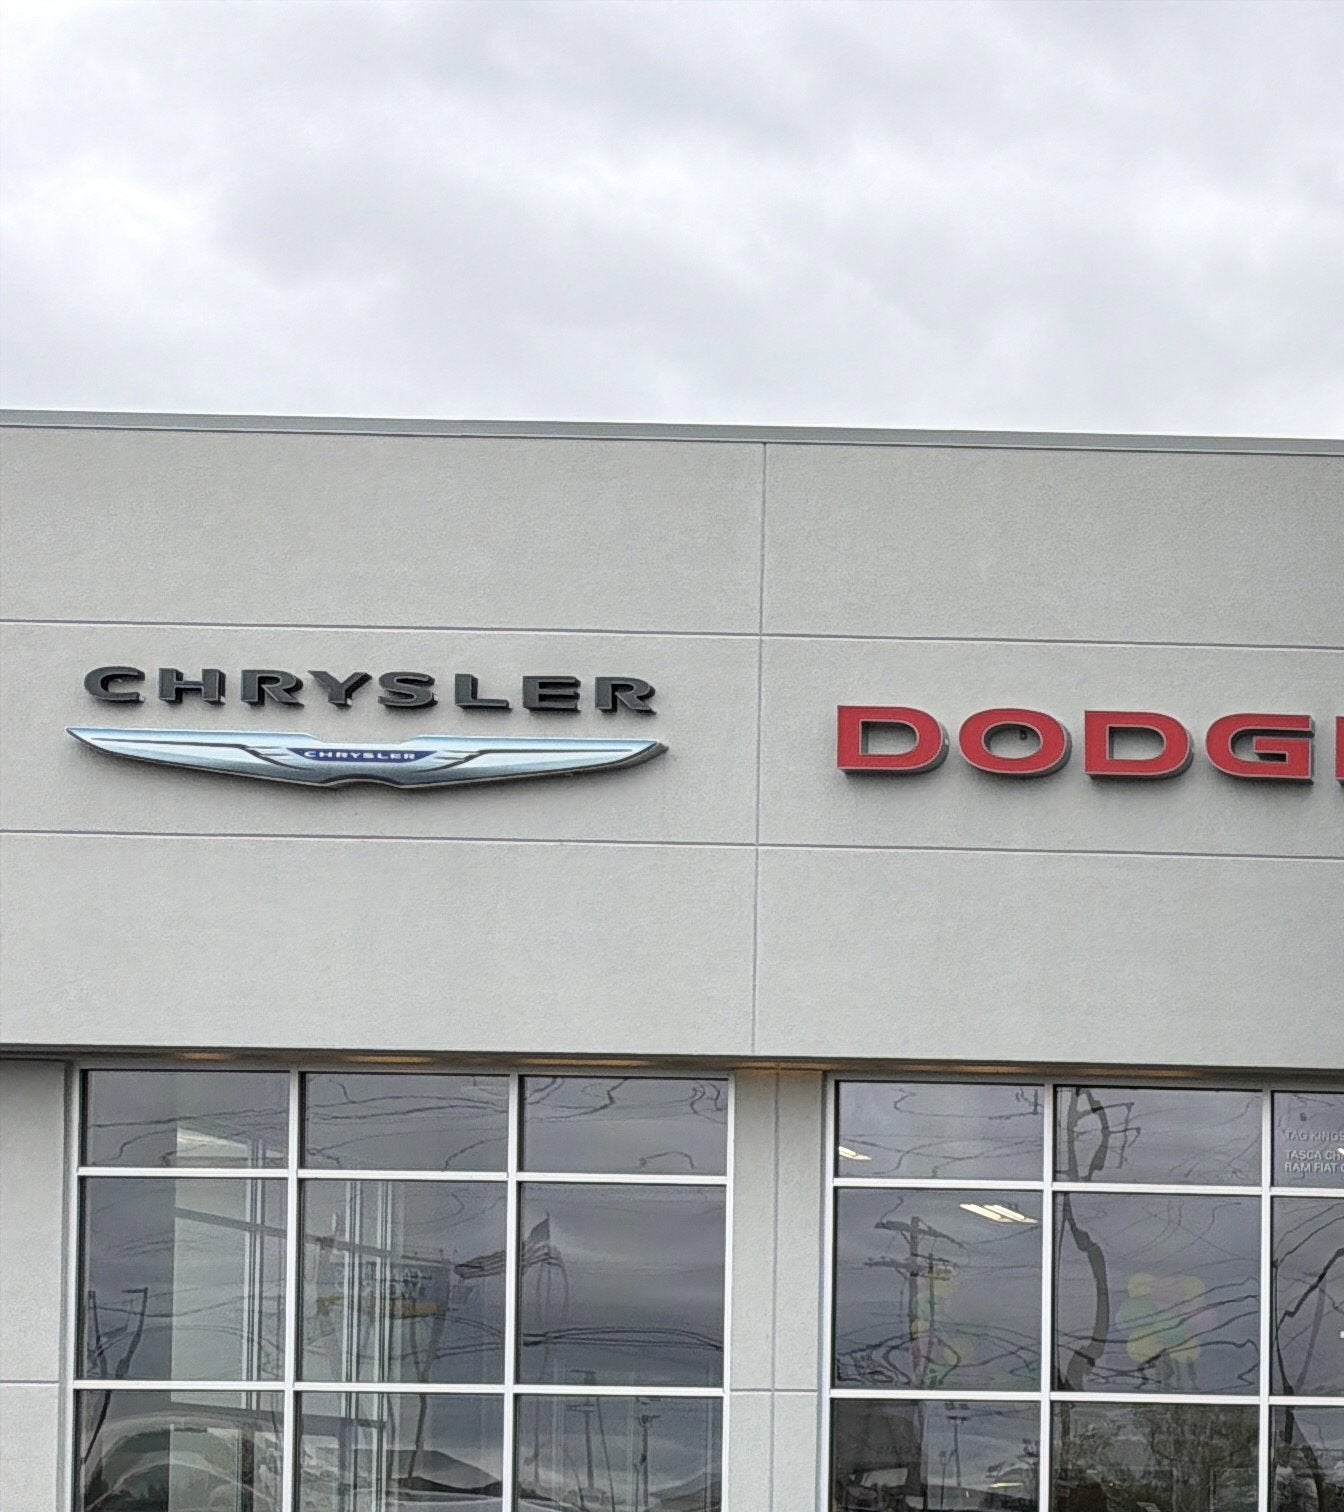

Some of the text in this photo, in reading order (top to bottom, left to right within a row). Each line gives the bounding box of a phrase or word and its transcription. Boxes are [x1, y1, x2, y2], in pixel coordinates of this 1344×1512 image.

[83, 666, 658, 715] CHRYSLER
[303, 750, 416, 760] CHRYSLER
[1286, 1149, 1323, 1161] TASCA
[1284, 1161, 1312, 1173] RAM
[1313, 1162, 1339, 1174] FIAT
